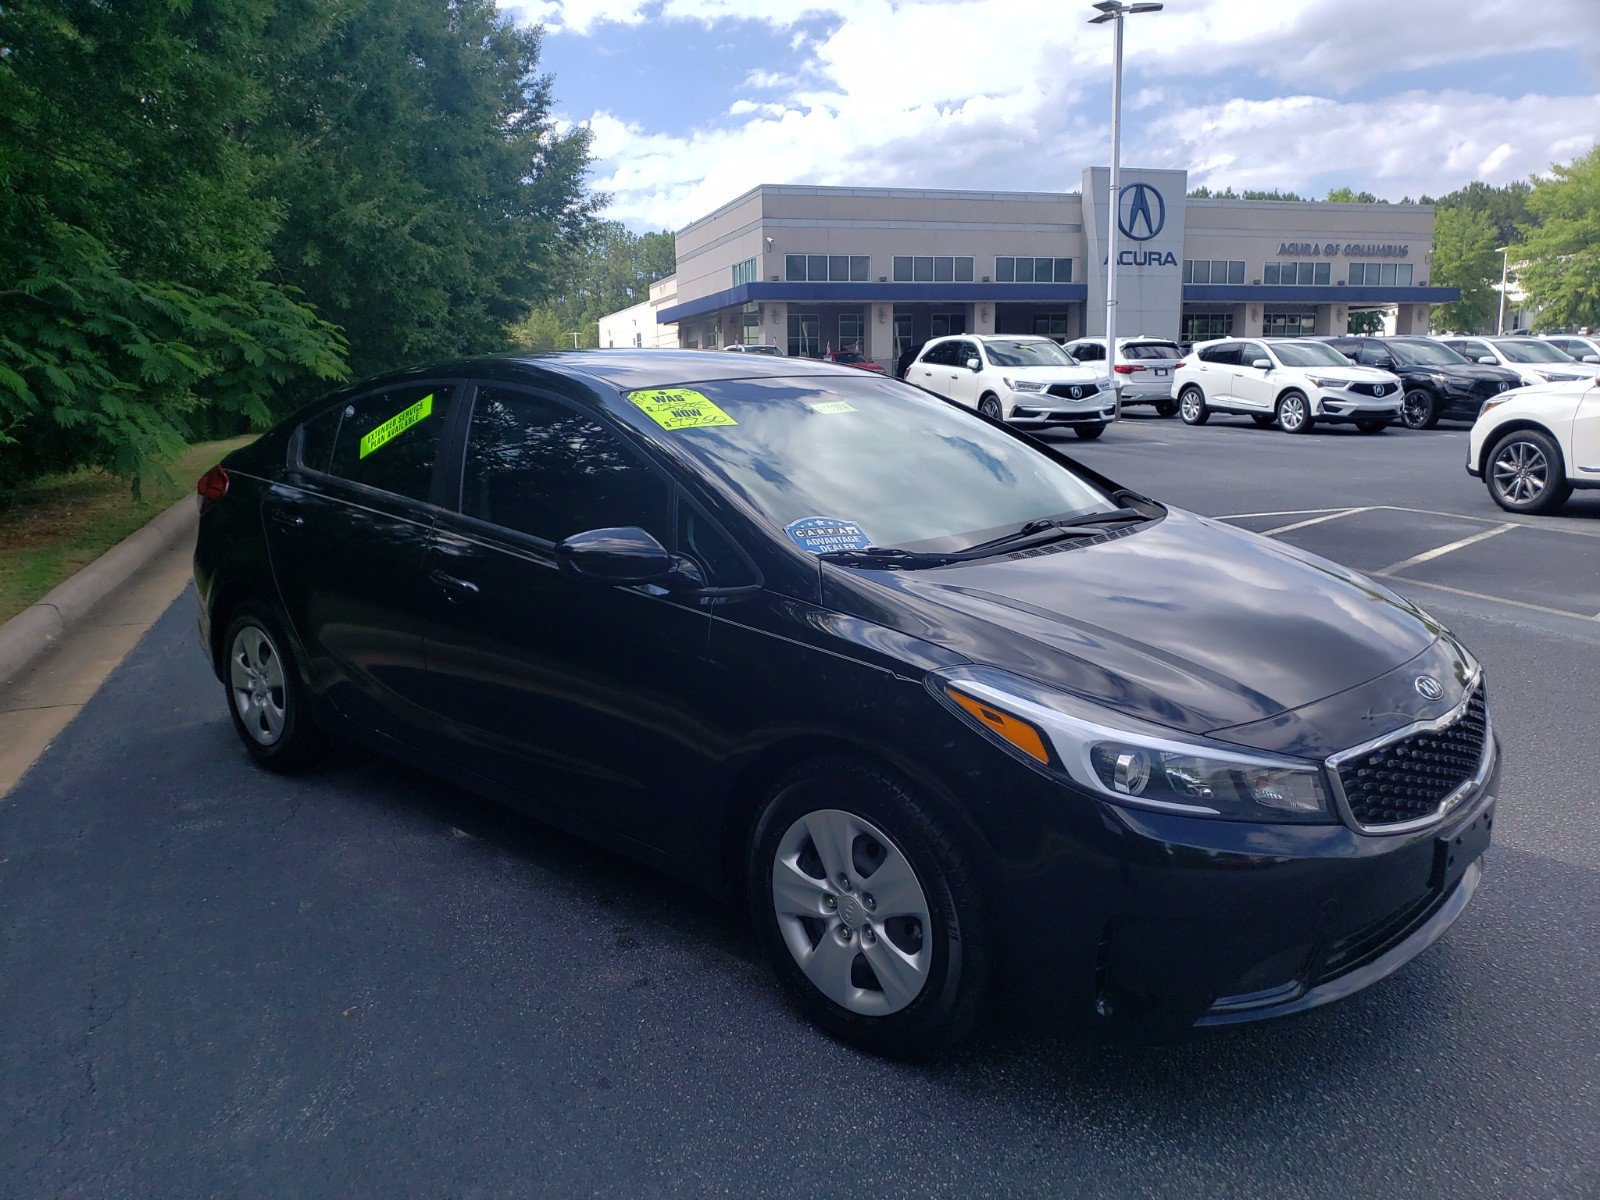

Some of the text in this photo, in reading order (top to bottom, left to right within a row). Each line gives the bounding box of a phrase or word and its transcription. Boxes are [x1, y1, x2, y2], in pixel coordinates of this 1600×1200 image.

[1277, 243, 1409, 257] ACURA OF COLUMBUS
[651, 395, 686, 403] WAS
[671, 409, 702, 418] NOW
[367, 401, 424, 443] EXTENDED SERVICE
[370, 412, 420, 450] PLAN AVAILABLE
[793, 526, 861, 538] CARFAX
[805, 535, 861, 546] ADVANTAGE
[819, 543, 857, 553] DEALER
